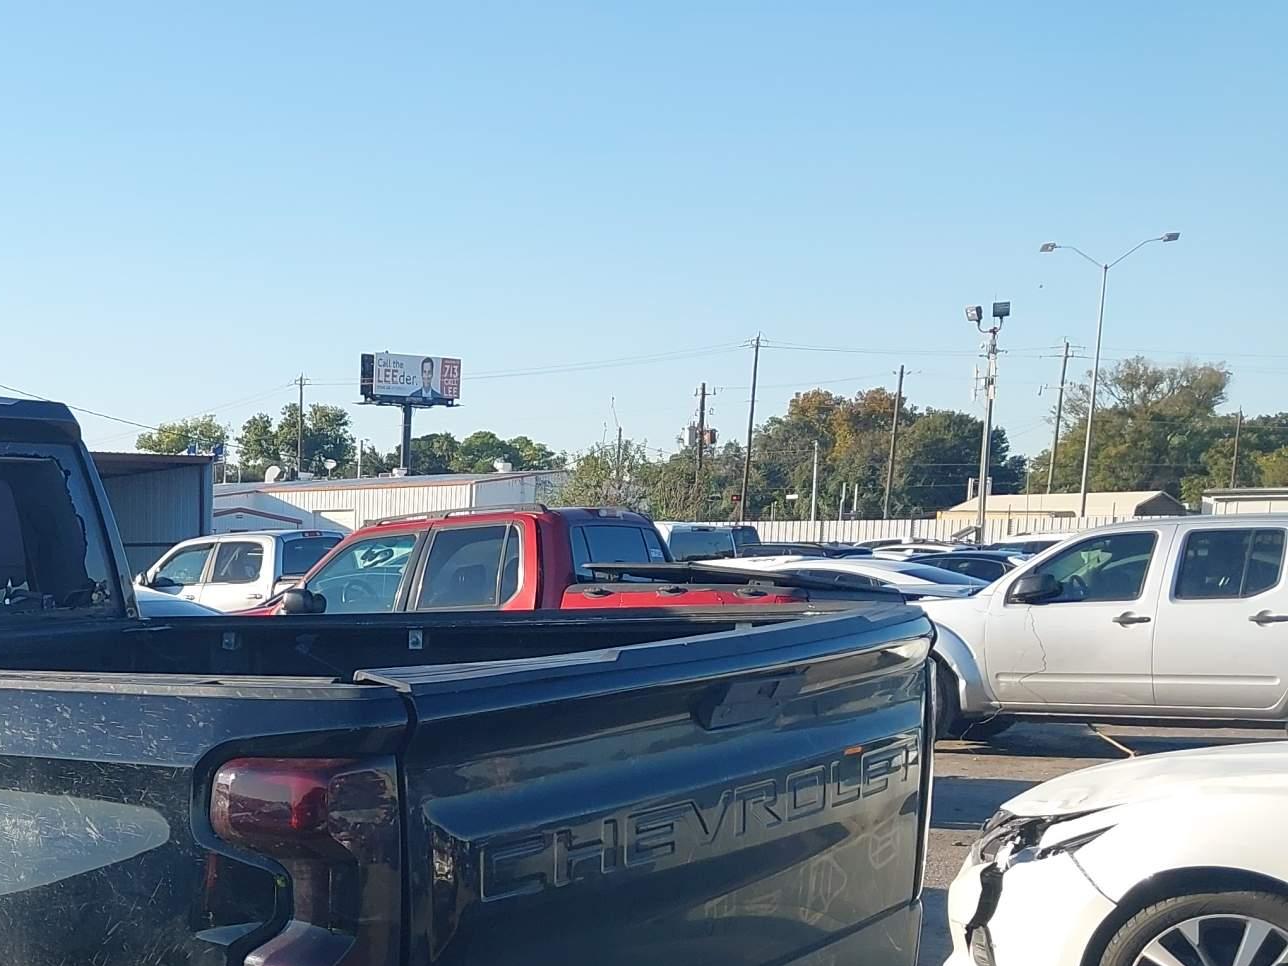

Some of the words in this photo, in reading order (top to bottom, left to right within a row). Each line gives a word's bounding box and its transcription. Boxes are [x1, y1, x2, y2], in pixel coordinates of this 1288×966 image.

[377, 358, 391, 368] Call
[392, 359, 404, 369] the
[377, 367, 418, 386] LEEder.
[444, 364, 458, 378] 713
[443, 386, 458, 398] LEE
[479, 737, 918, 903] CHEVROLET
